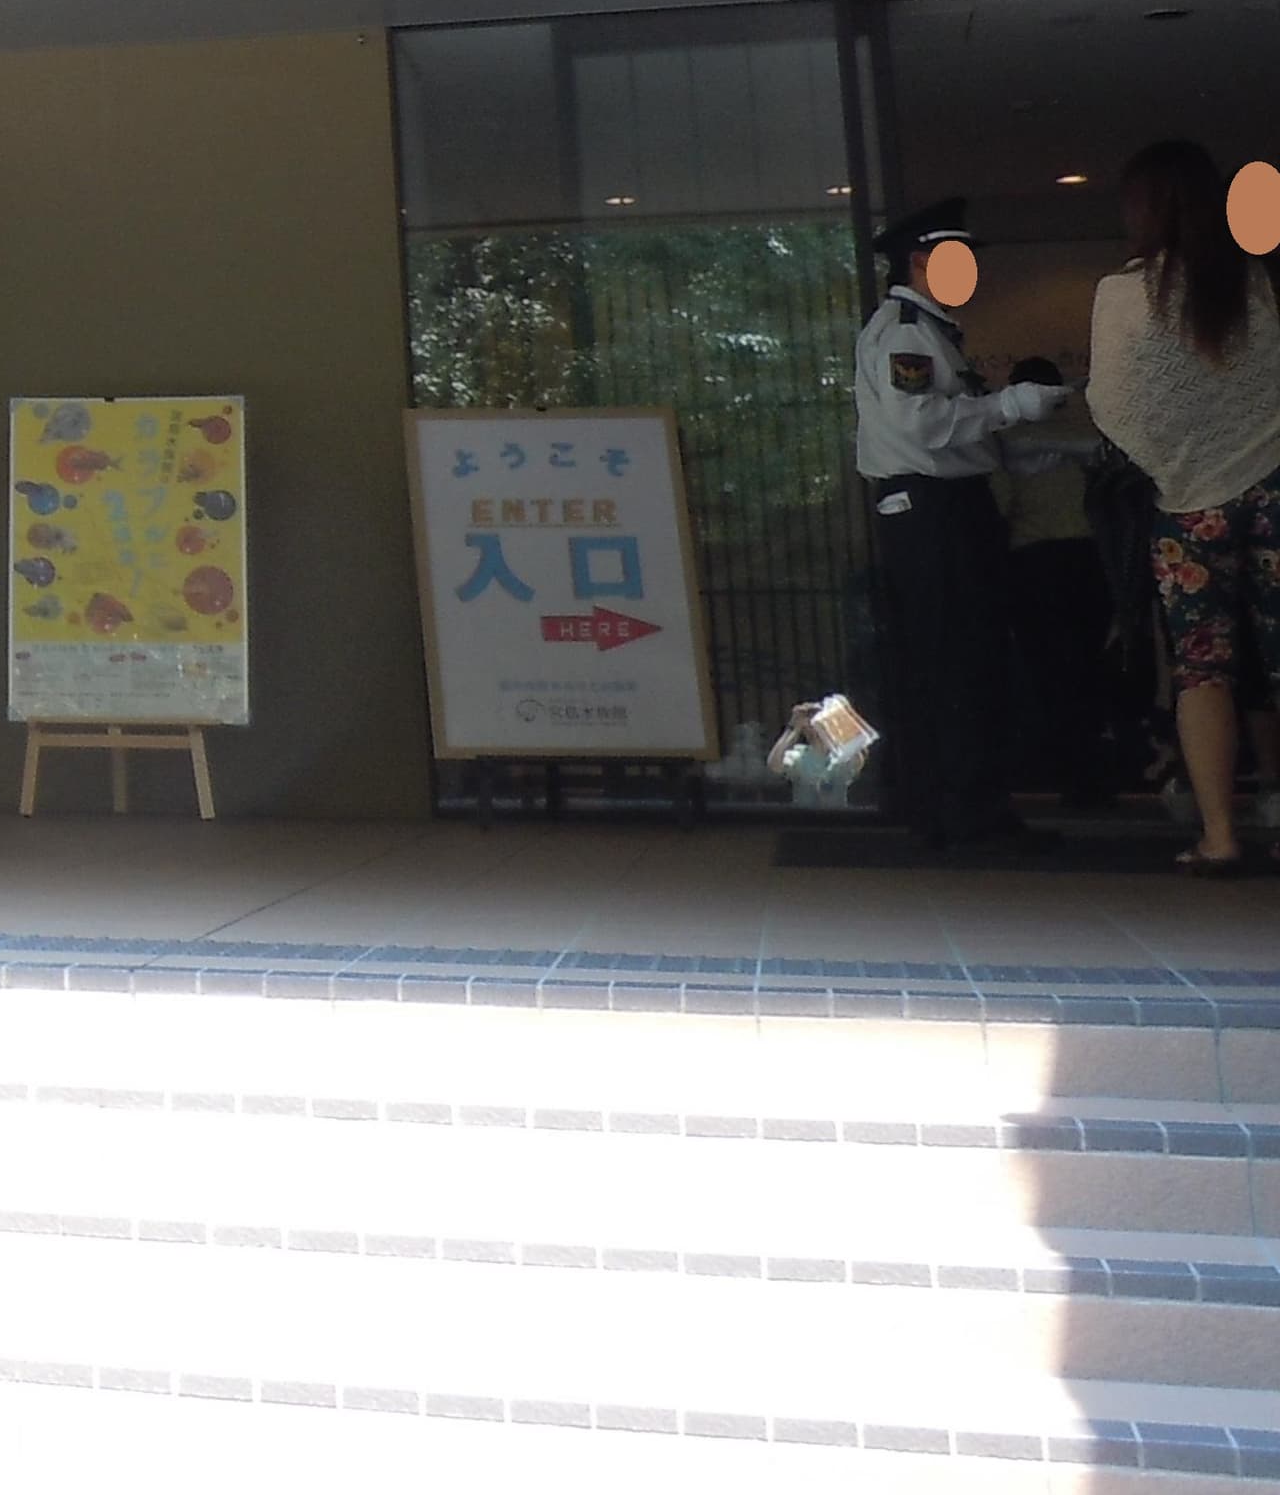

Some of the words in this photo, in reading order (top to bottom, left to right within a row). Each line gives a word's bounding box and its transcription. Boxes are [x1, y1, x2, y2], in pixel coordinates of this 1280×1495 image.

[451, 441, 631, 478] ようこそ
[471, 498, 618, 524] ENTER
[453, 532, 644, 603] 入口
[560, 621, 631, 638] HERE
